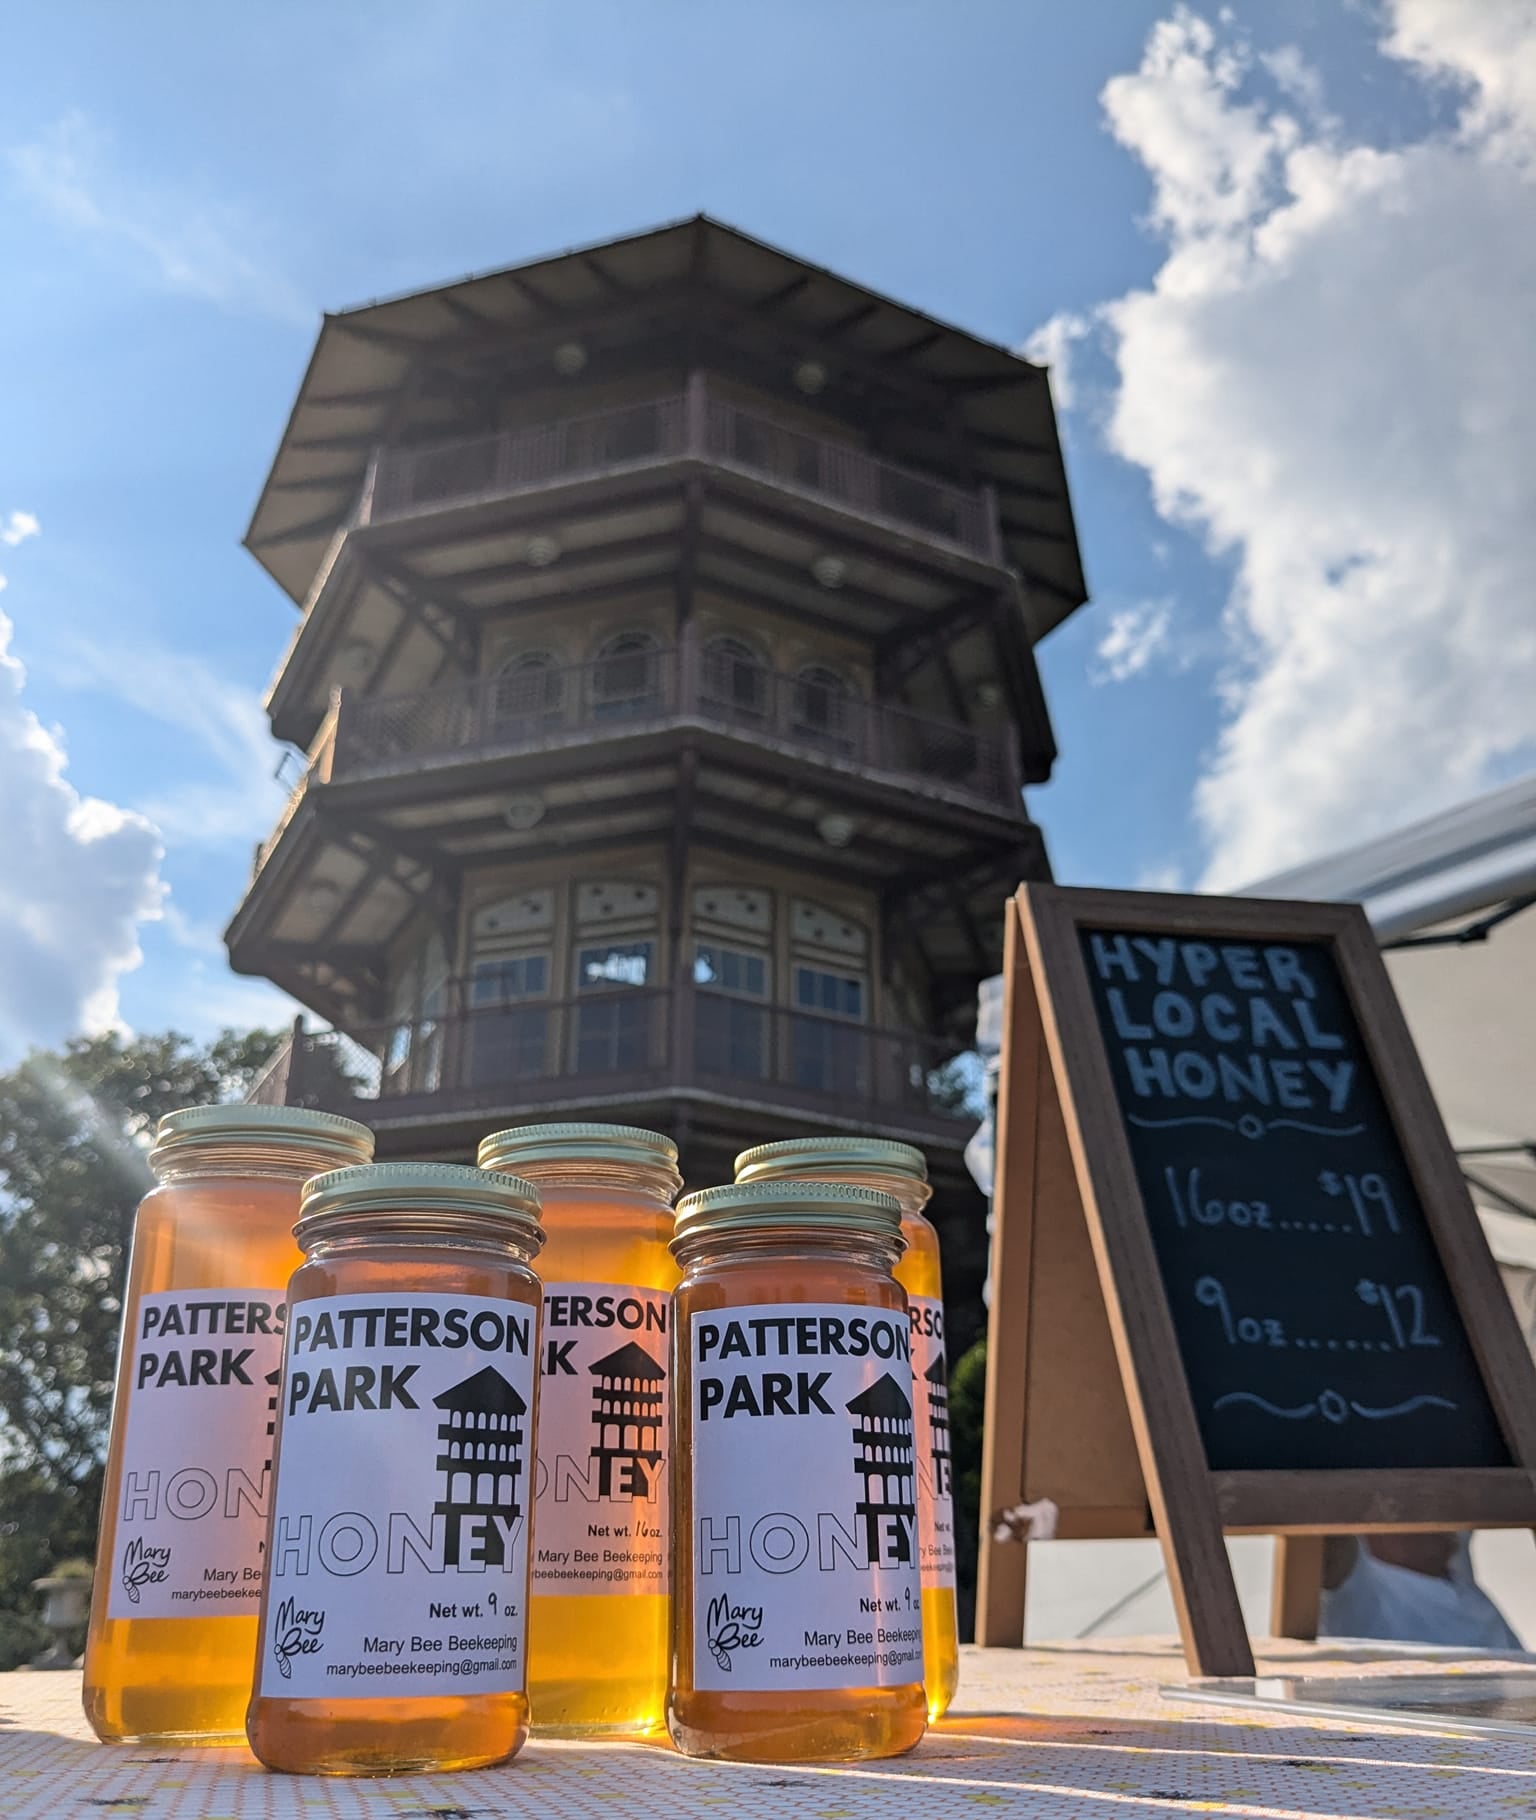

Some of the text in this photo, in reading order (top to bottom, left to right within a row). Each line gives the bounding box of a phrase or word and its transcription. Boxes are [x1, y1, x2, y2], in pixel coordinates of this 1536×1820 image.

[1090, 934, 1317, 997] HYPER
[1106, 990, 1344, 1050] LOCAL
[1123, 1047, 1357, 1112] HONEY
[142, 1302, 287, 1339] PATTERS
[293, 1308, 530, 1356] PATTERSON
[544, 1296, 666, 1334] ERSON
[699, 1318, 910, 1362] PATTERSON
[138, 1348, 255, 1389] PARK
[289, 1364, 421, 1416] PARK
[700, 1372, 835, 1421] PARK
[124, 1467, 270, 1521] HON
[536, 1455, 666, 1504] NEY
[275, 1512, 524, 1576] HONEY
[588, 1524, 609, 1537] Net
[614, 1525, 631, 1537] wt.
[635, 1520, 649, 1537] 16
[701, 1513, 918, 1574] HONEY
[123, 1536, 171, 1573] Mary
[128, 1561, 170, 1586] Bee
[538, 1550, 662, 1565] Mary Bee Beekeeping
[203, 1567, 262, 1584] Mary Be
[532, 1567, 663, 1581] beebeekeeping@gmail.com
[275, 1596, 325, 1640] Mary
[429, 1592, 518, 1618] Net wt. 9 oz.
[707, 1593, 763, 1637] Mary
[860, 1598, 882, 1613] Net
[886, 1598, 901, 1612] wt.
[904, 1587, 911, 1610] 9
[281, 1627, 324, 1657] Bee
[363, 1634, 517, 1656] Mary Bee Beekeeping
[714, 1622, 764, 1650] Bee
[804, 1631, 842, 1648] Mary
[847, 1629, 873, 1645] Bee
[326, 1658, 517, 1679] marybeebeekeeping@gmail.com
